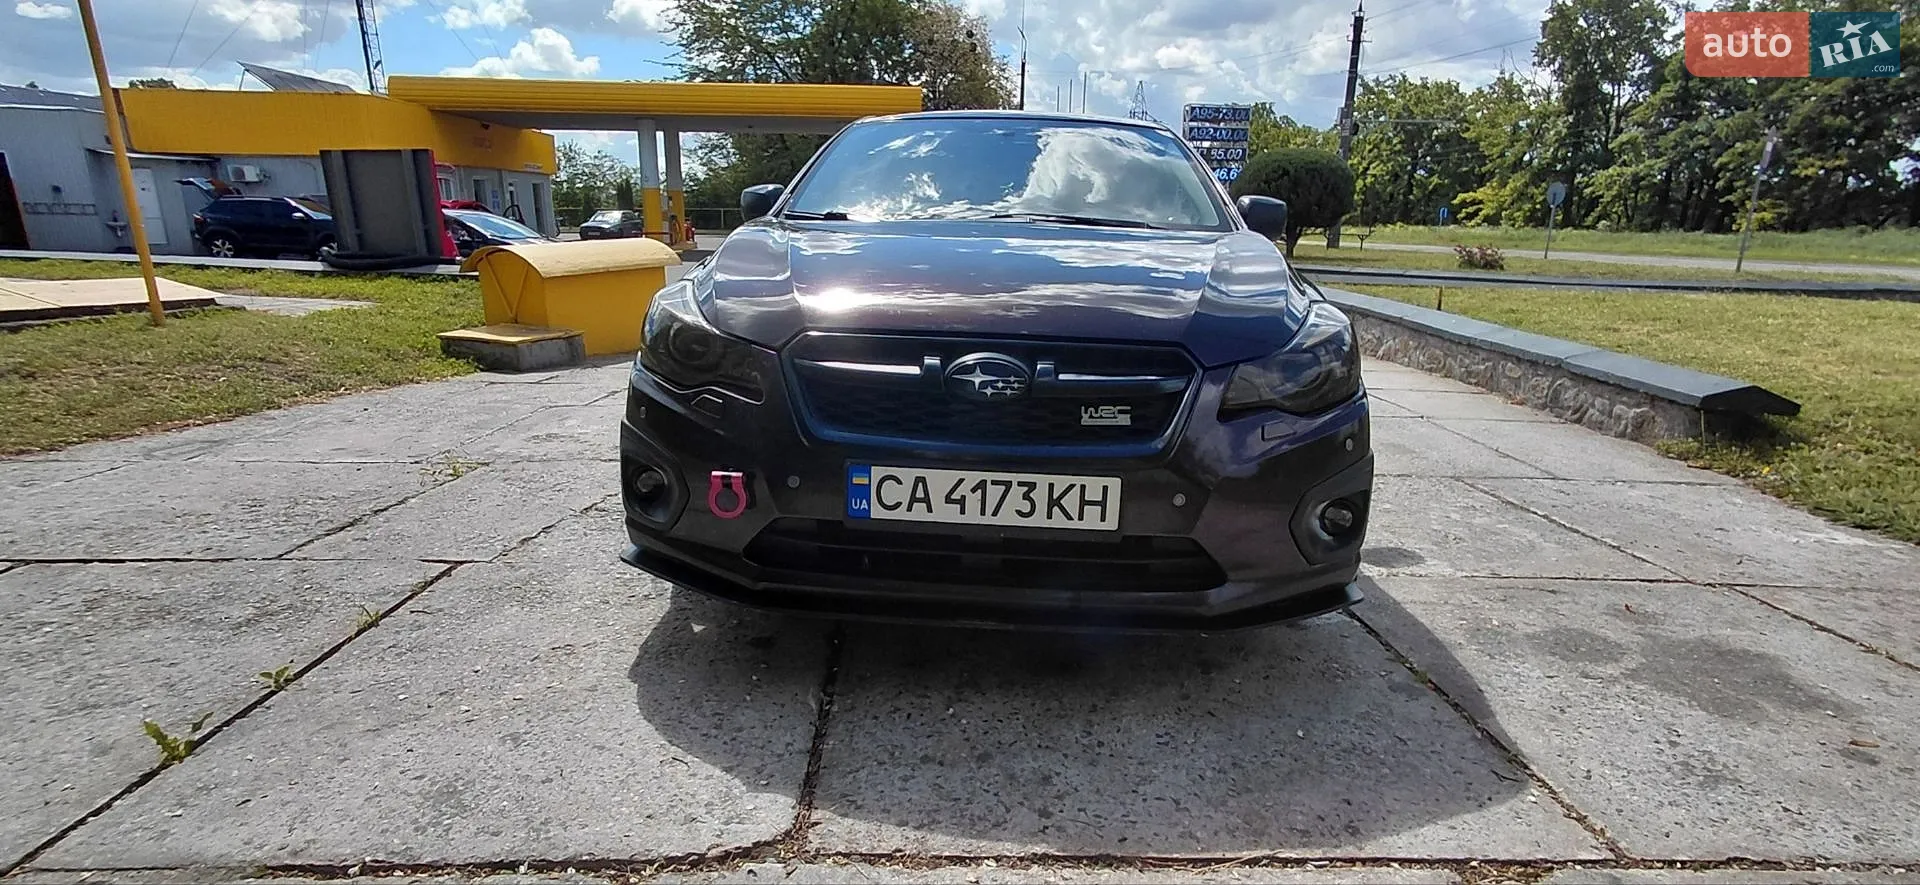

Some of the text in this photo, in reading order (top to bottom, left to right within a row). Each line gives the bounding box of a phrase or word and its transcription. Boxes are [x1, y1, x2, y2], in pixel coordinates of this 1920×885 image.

[851, 498, 868, 510] UA
[875, 474, 1109, 522] CA 4173 KH
